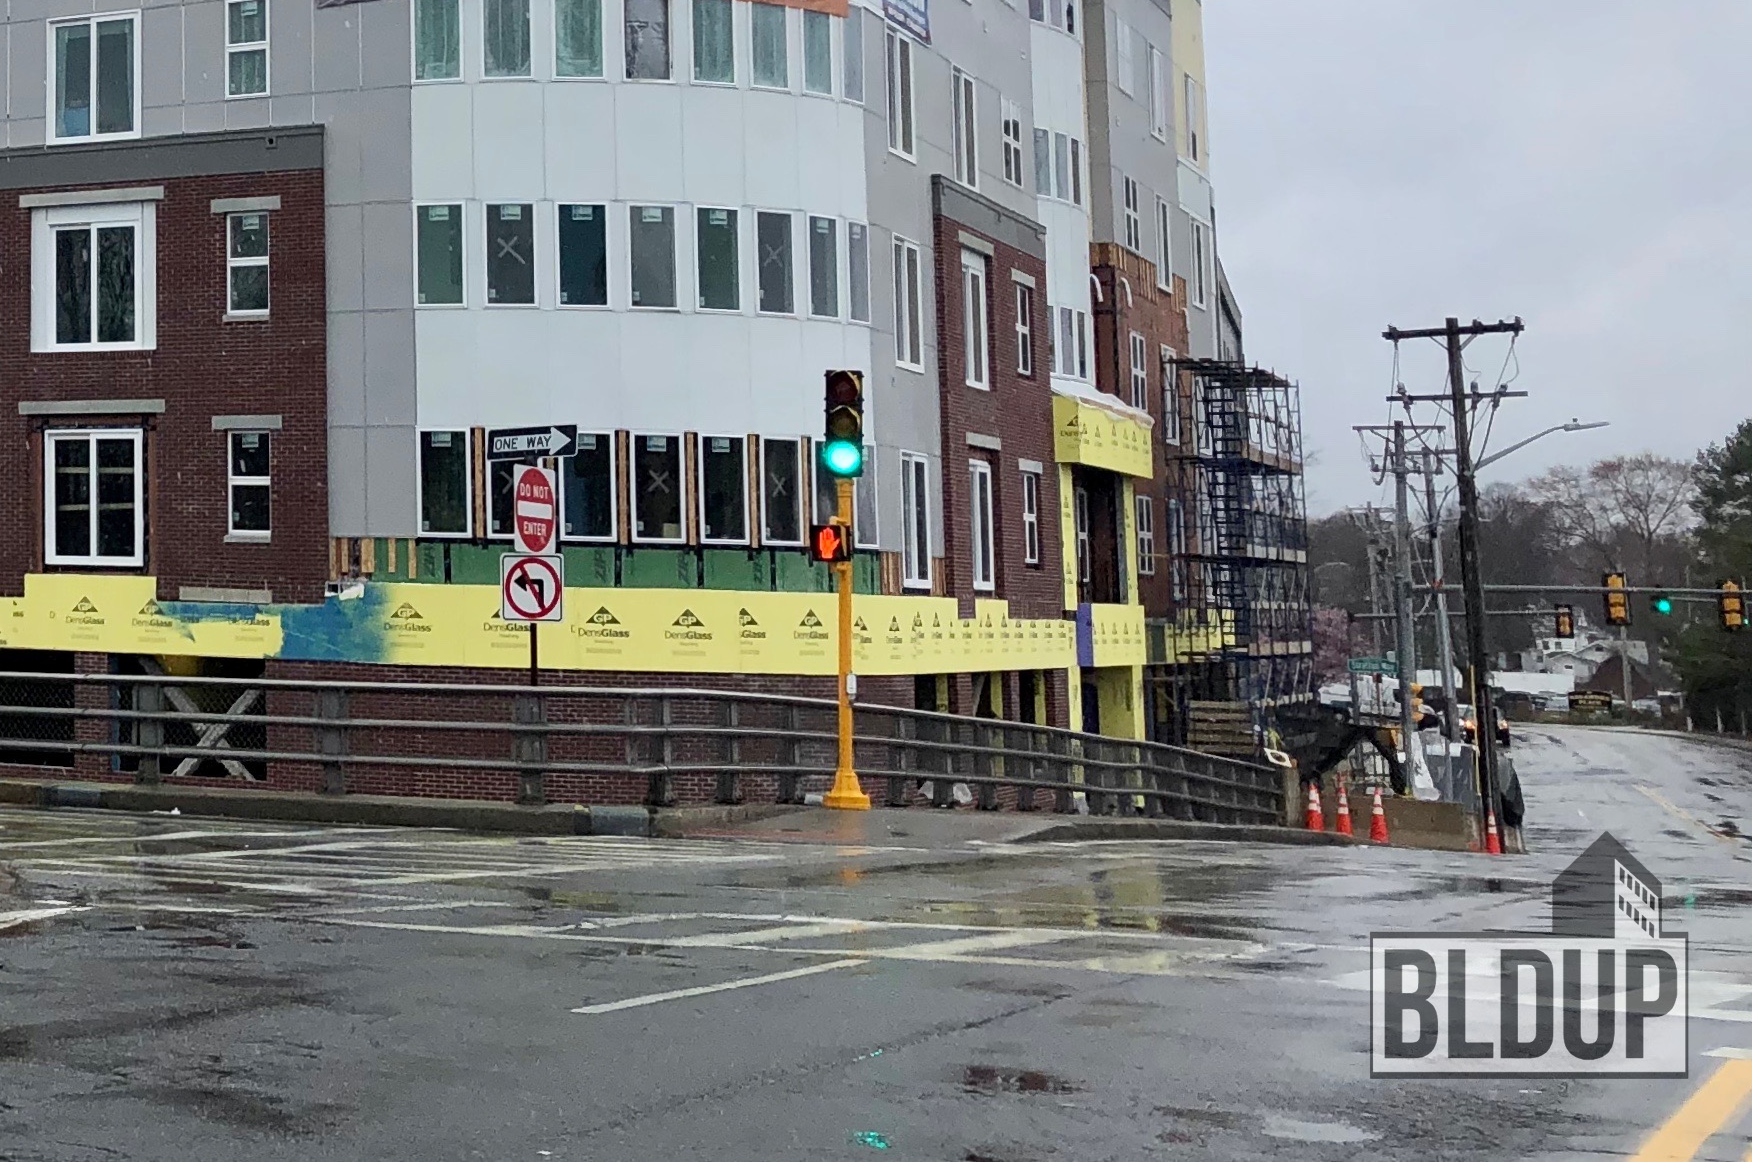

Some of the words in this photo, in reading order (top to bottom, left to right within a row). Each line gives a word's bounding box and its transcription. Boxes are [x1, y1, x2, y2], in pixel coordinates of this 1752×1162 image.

[494, 437, 519, 451] ONE
[526, 435, 552, 449] WAY
[520, 482, 531, 497] DO
[533, 484, 549, 499] NOT
[523, 522, 547, 537] ENTER
[483, 622, 531, 632] DensGlas
[578, 628, 630, 638] DensGlass
[665, 630, 713, 640] DensGlass
